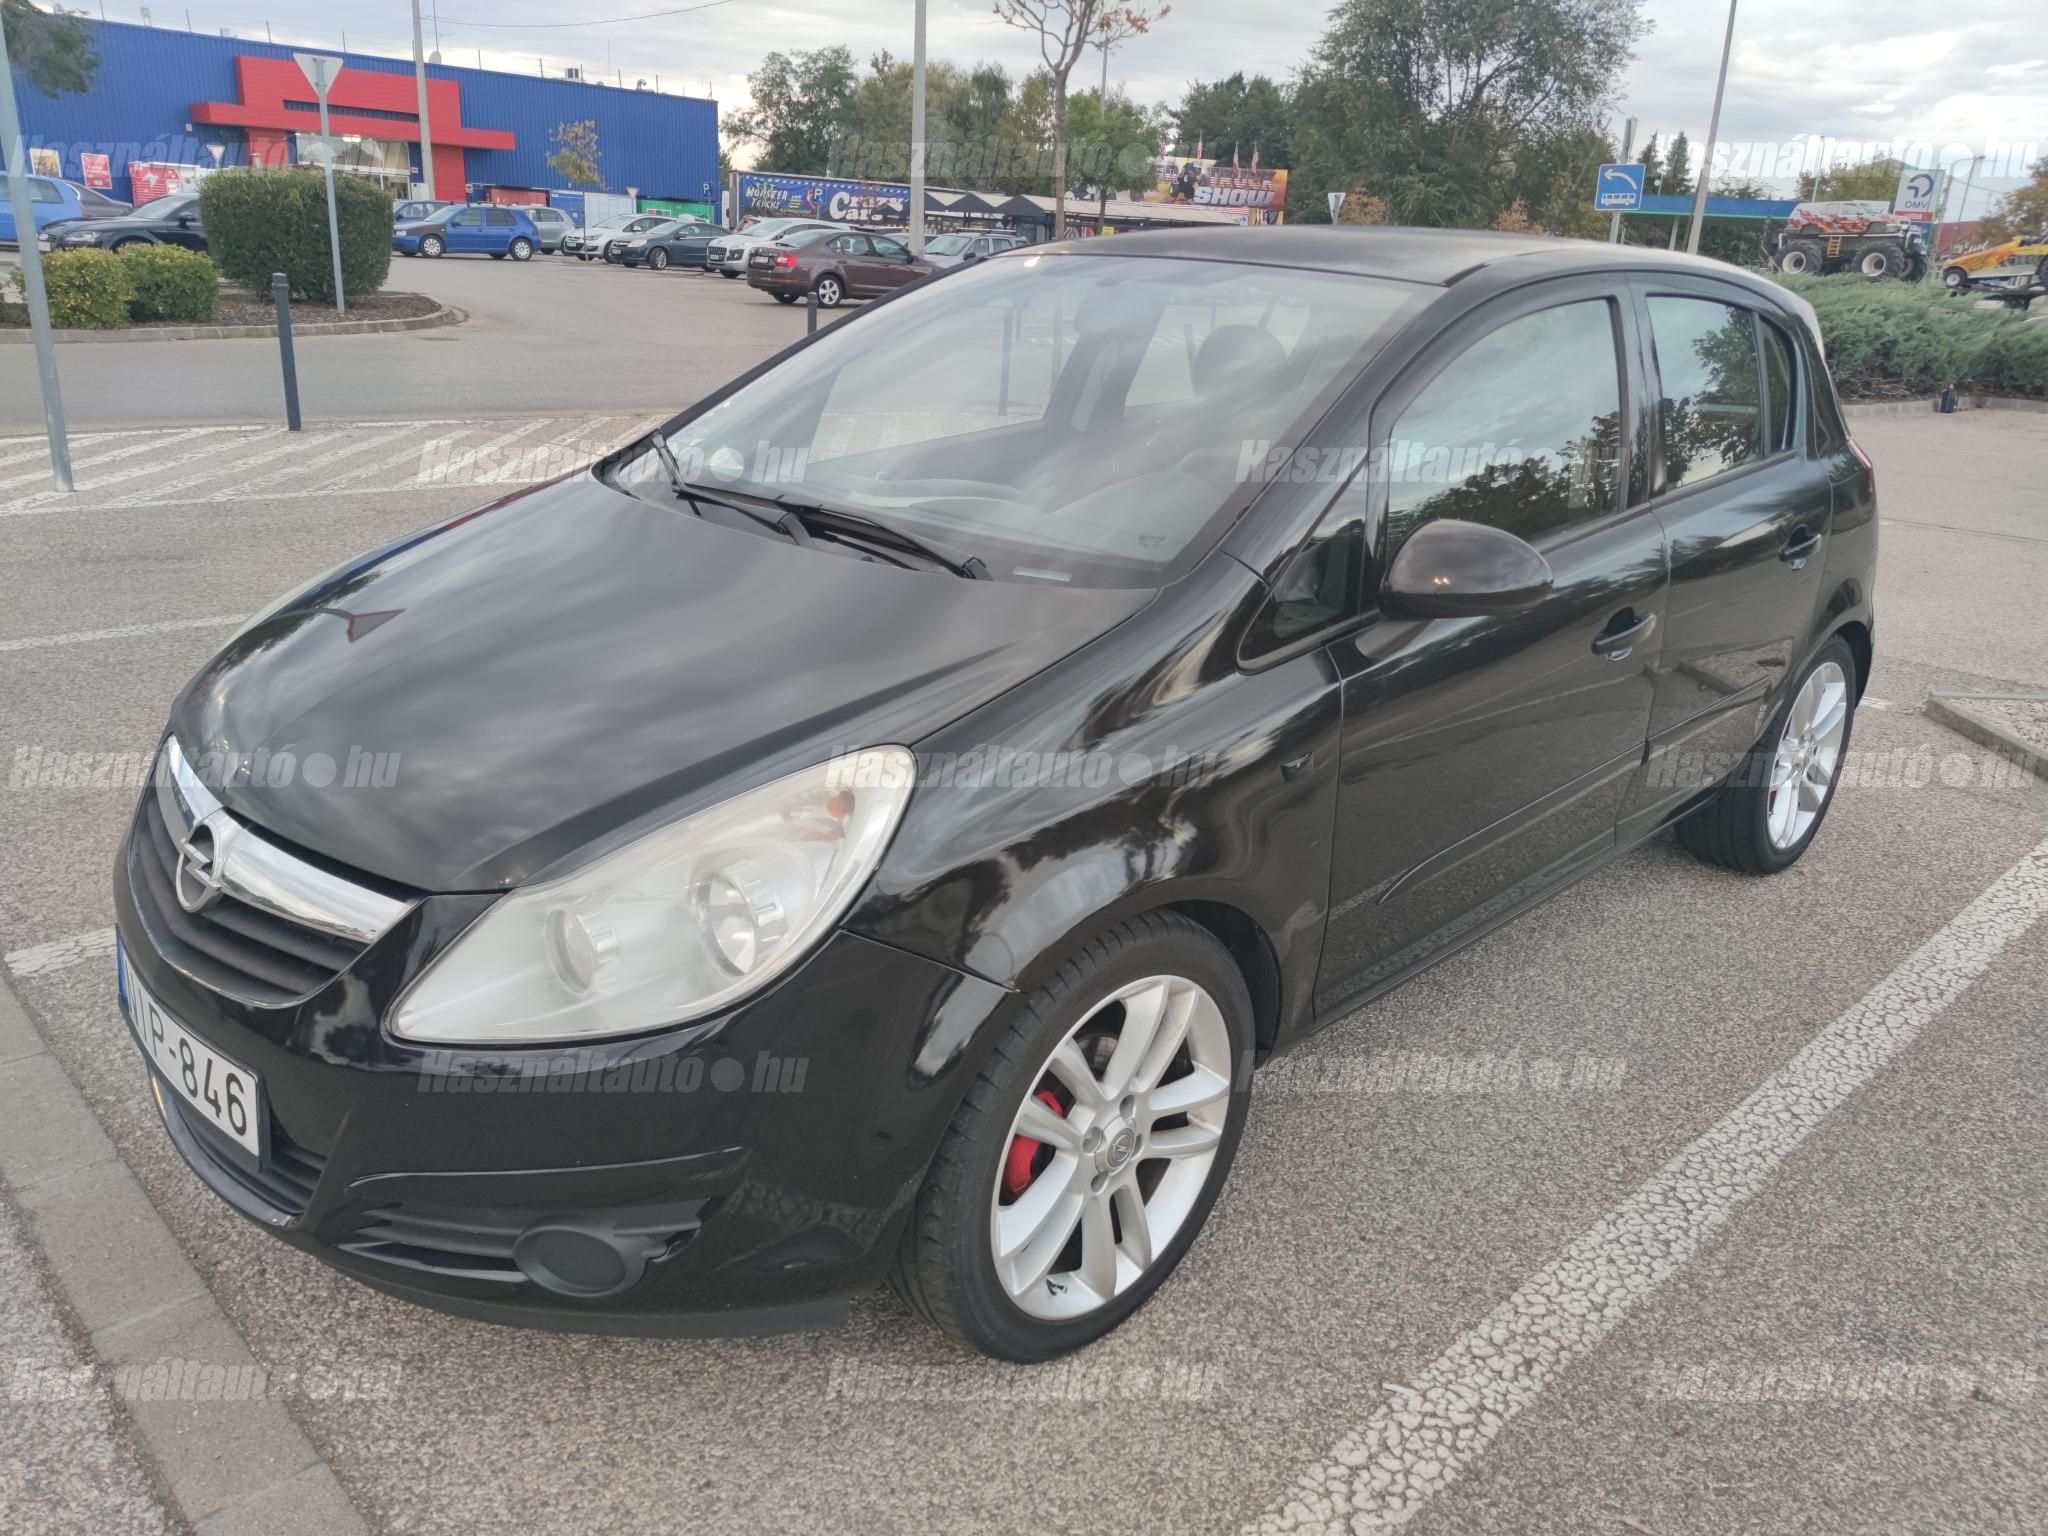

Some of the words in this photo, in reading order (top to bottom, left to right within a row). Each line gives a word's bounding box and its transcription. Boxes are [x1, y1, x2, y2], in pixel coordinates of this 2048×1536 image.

[703, 184, 710, 194] P
[746, 186, 788, 201] MONSTER
[814, 188, 823, 199] P
[1194, 186, 1275, 207] SHOW
[1905, 201, 1929, 209] OMV
